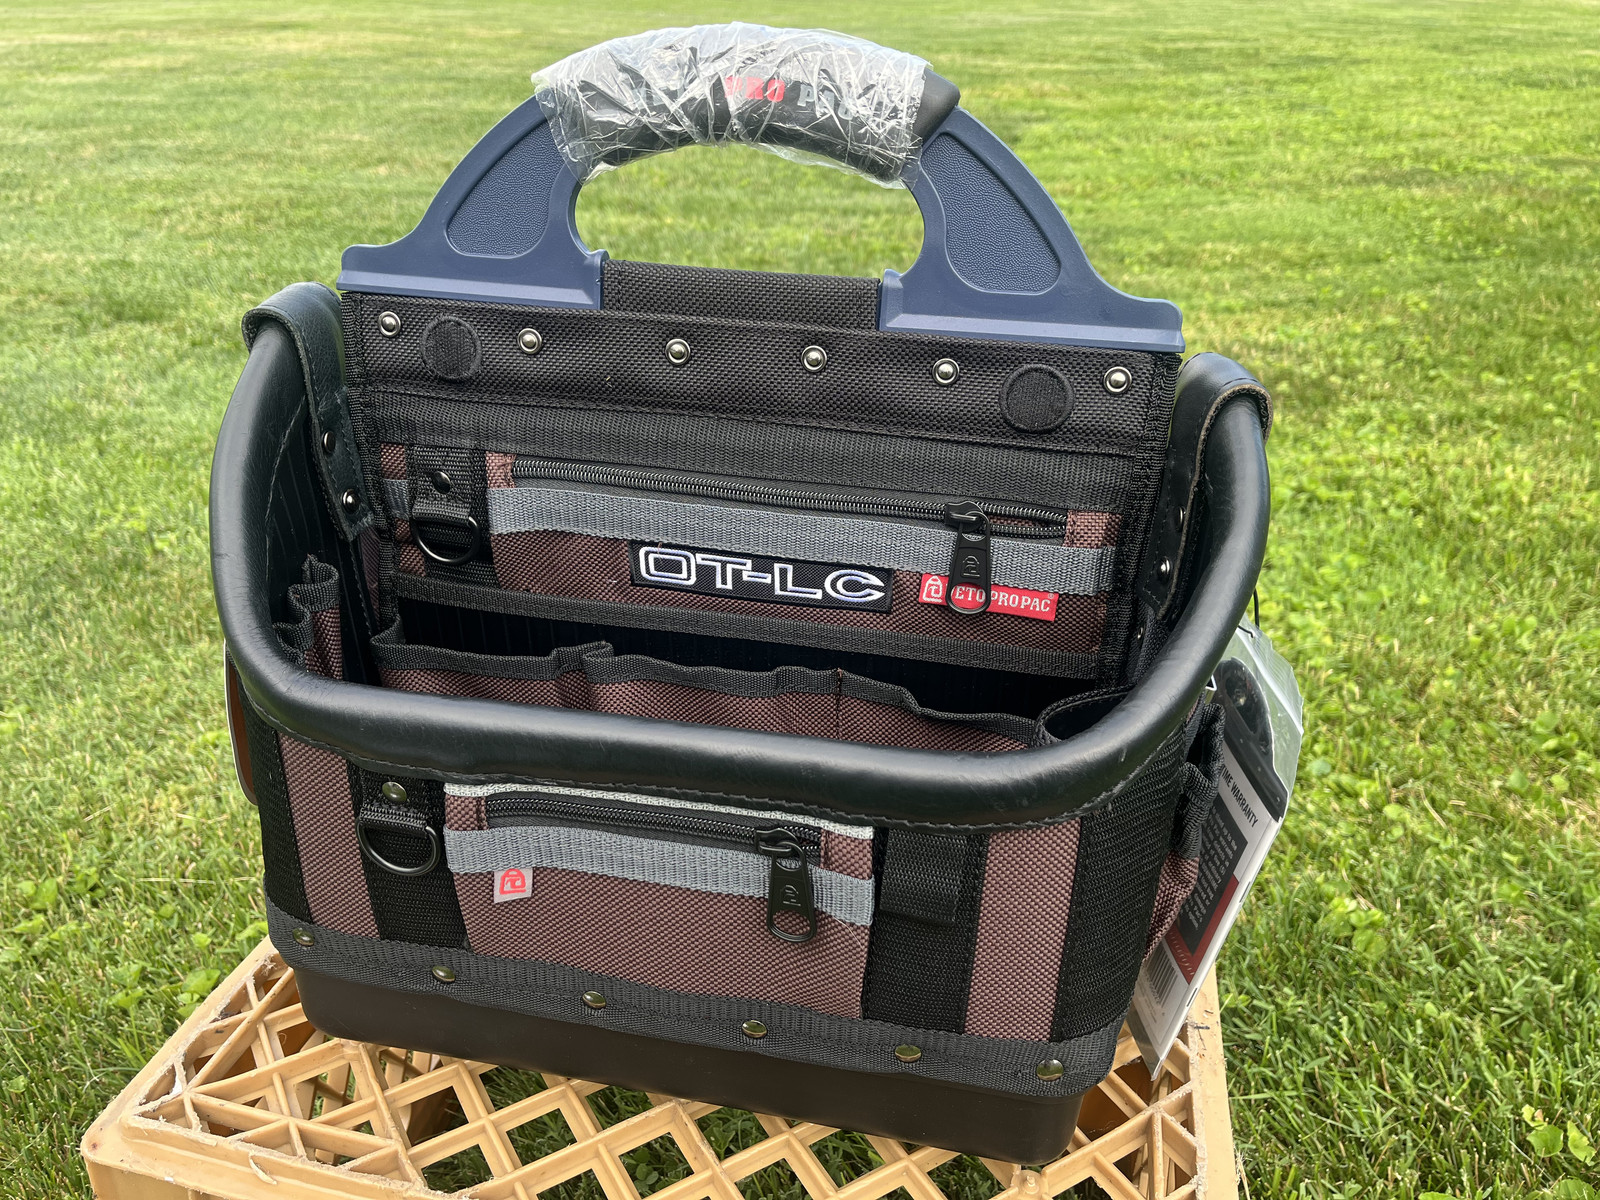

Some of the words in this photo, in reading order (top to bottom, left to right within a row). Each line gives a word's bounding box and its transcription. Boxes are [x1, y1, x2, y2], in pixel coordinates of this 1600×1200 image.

[725, 76, 786, 103] PRO
[638, 546, 886, 603] OT-LC
[948, 583, 987, 603] ETO
[1230, 781, 1259, 828] WARRANTY
